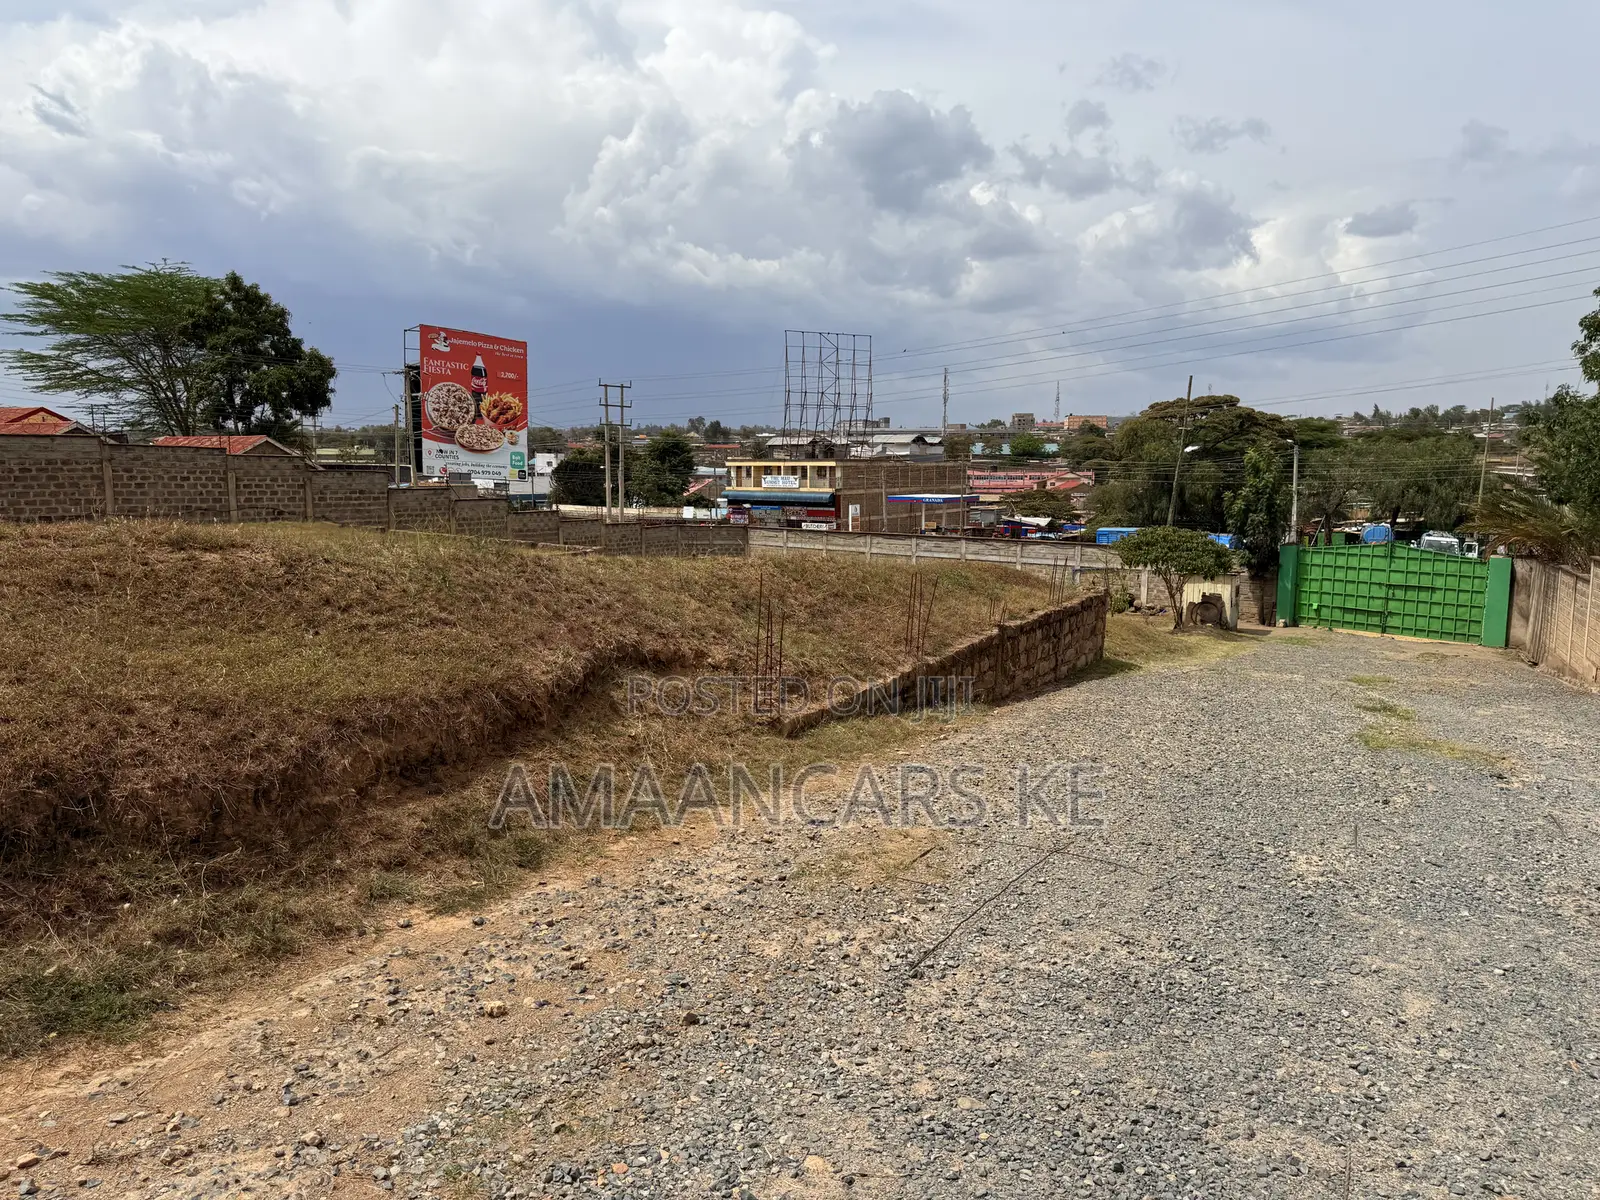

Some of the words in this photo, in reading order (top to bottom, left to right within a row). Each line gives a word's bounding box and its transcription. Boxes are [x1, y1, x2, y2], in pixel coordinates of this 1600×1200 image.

[478, 341, 493, 349] Pizza
[500, 345, 524, 354] Chicken
[423, 357, 469, 371] FANTASTIC
[423, 365, 452, 376] FIESTA
